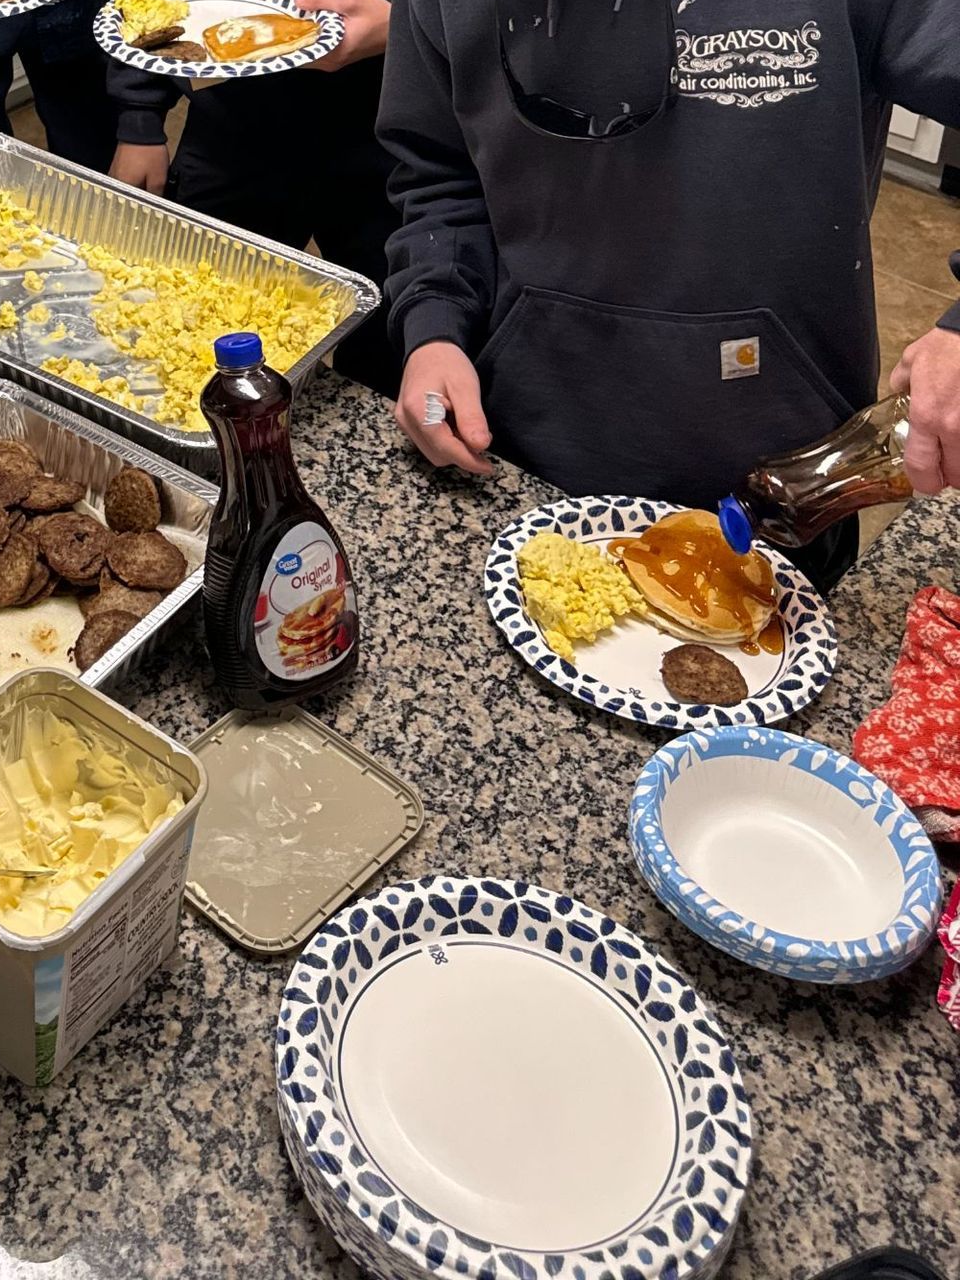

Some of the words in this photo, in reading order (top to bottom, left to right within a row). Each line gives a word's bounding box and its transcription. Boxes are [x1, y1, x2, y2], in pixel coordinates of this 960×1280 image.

[678, 74, 696, 90] air
[700, 71, 790, 90] conditioning,
[794, 69, 817, 85] inc.
[291, 557, 331, 589] Original
